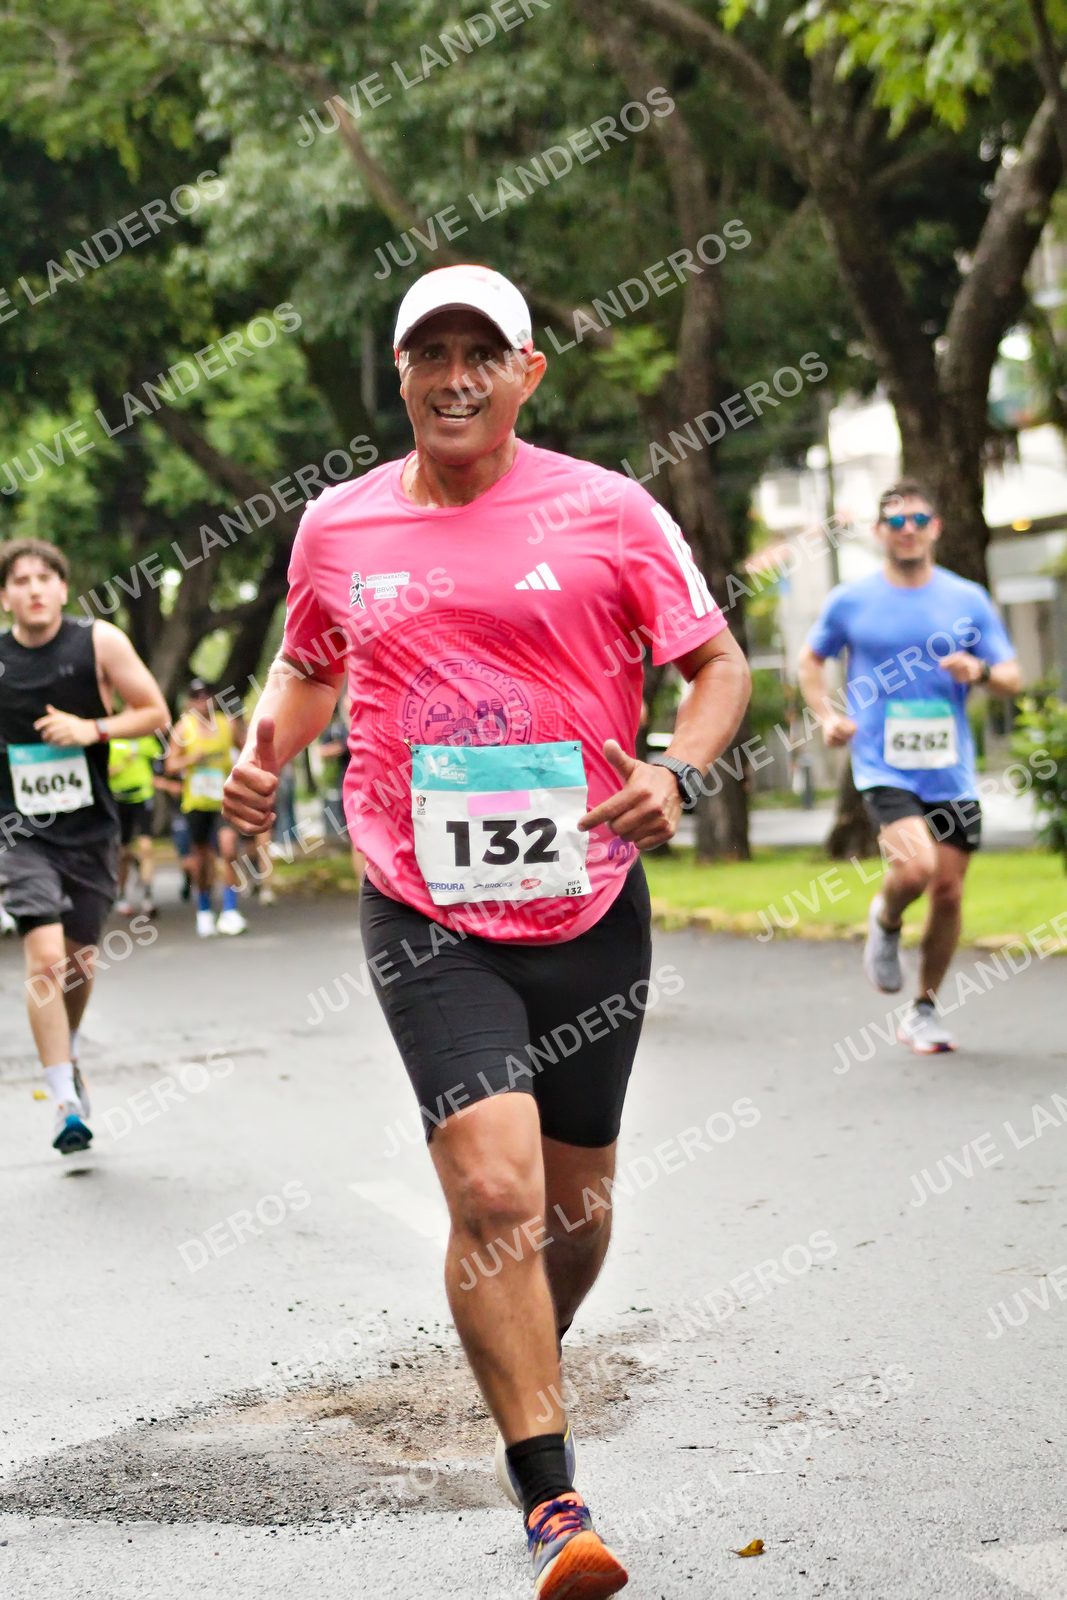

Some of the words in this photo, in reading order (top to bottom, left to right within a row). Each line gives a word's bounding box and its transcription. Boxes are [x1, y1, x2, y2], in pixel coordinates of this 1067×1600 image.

[892, 729, 948, 752] 6262
[21, 771, 83, 796] 4604
[446, 818, 560, 867] 132
[565, 886, 582, 895] 132
